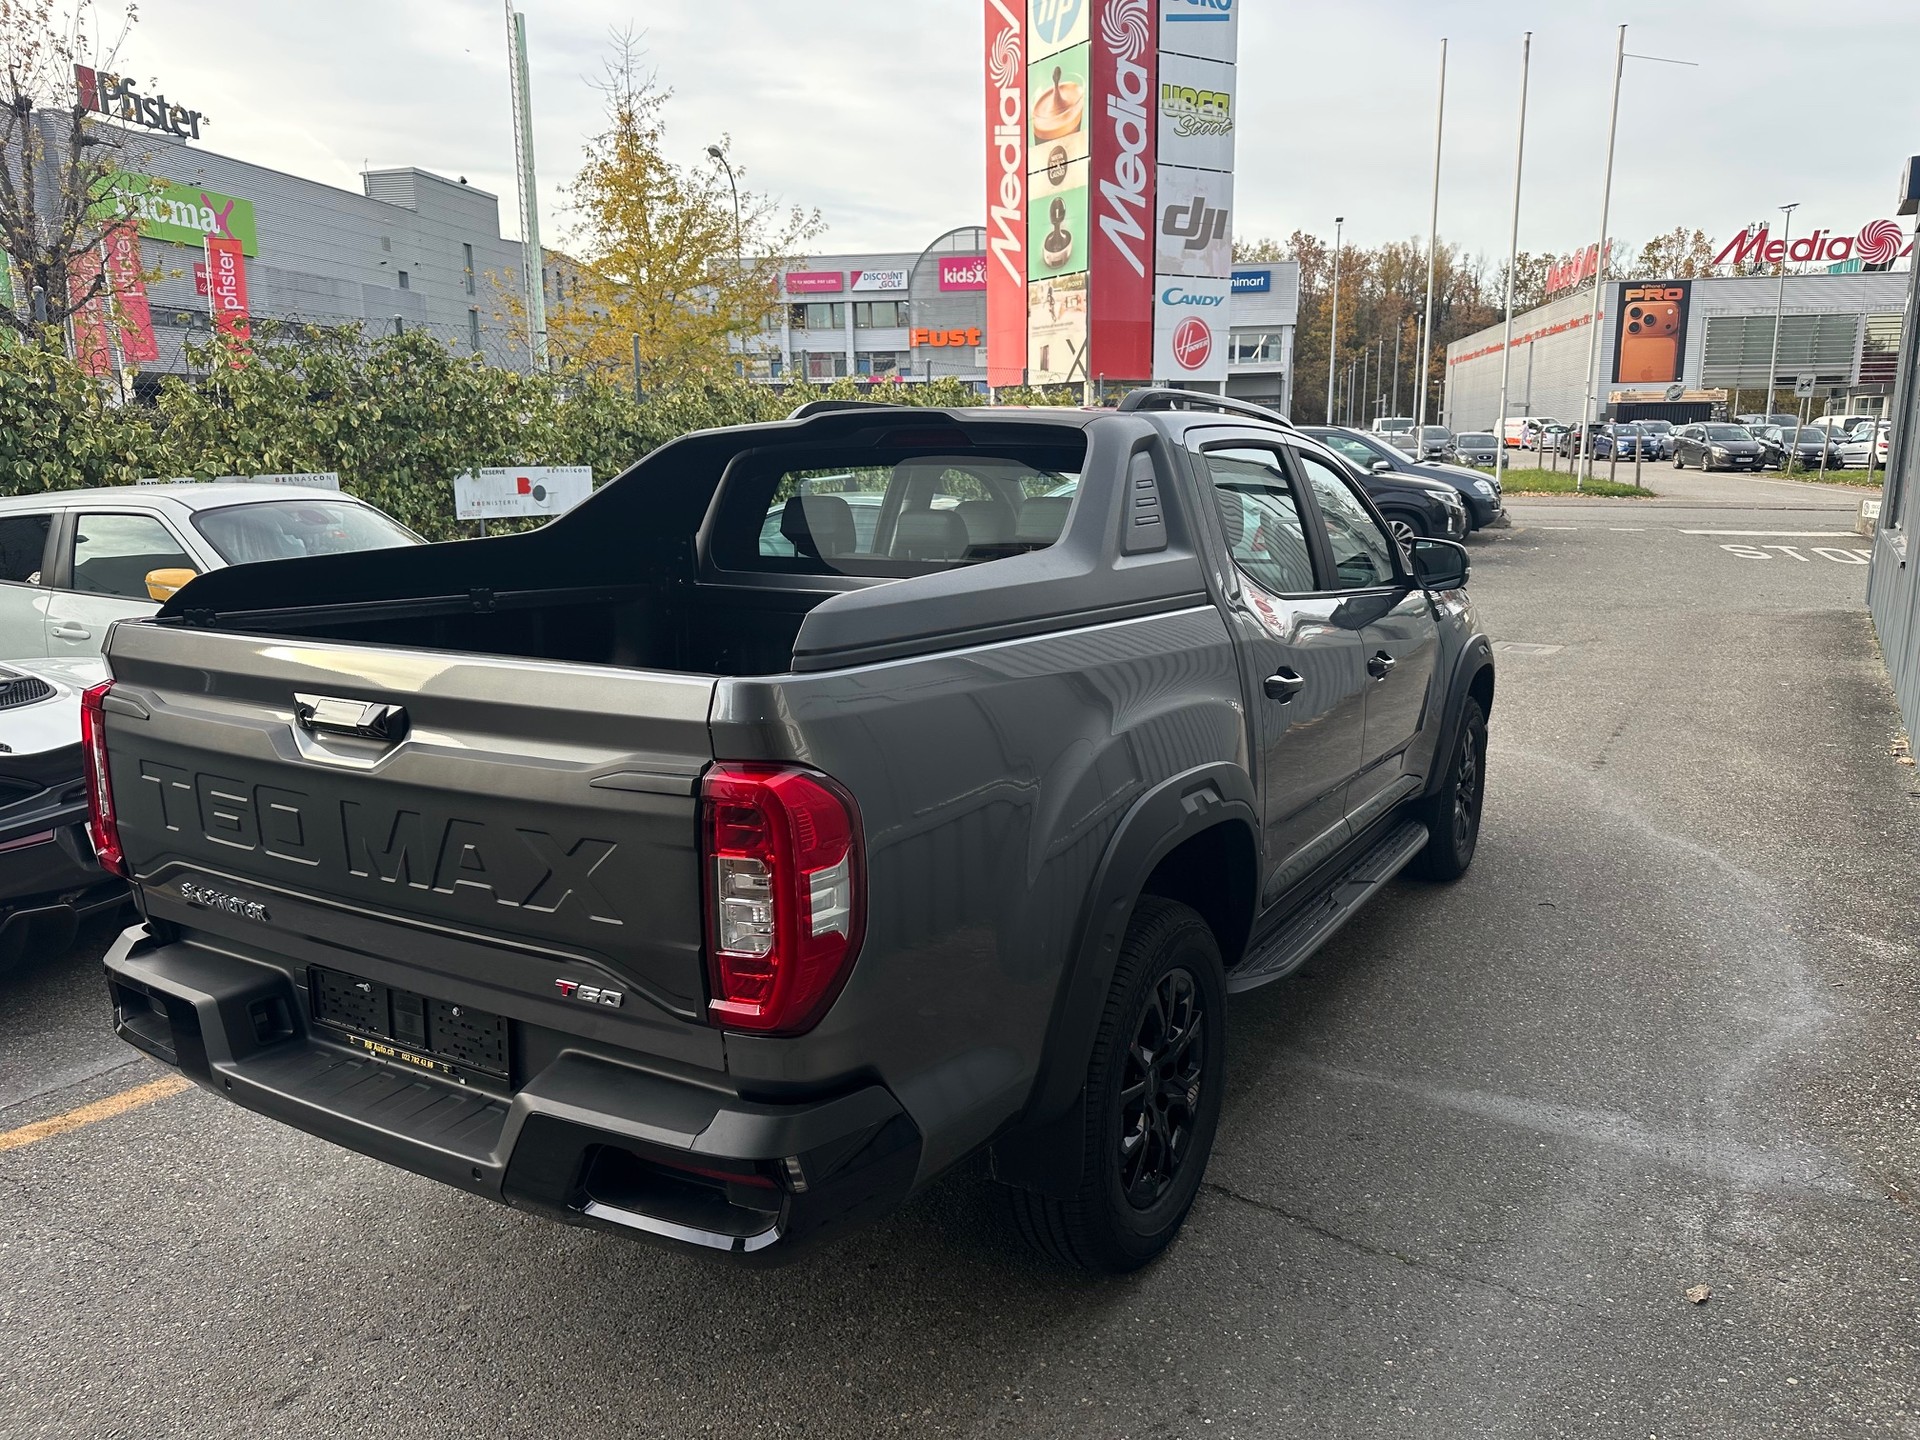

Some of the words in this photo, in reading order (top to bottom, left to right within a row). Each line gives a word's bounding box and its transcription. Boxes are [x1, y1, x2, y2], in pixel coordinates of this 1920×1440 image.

[97, 71, 202, 139] Pfister
[1162, 84, 1230, 123] UBER
[1174, 113, 1233, 137] Scoot
[1100, 56, 1148, 278] Media
[991, 87, 1021, 287] Media
[1711, 229, 1856, 265] Media
[217, 249, 244, 310] pfister
[863, 271, 904, 281] DISCOUNT
[1625, 288, 1683, 302] PRO
[916, 326, 981, 347] Fust
[274, 475, 335, 483] BERNASCONI
[340, 800, 624, 925] MAX
[555, 979, 623, 1008] T60
[373, 1042, 395, 1057] Auto.ch
